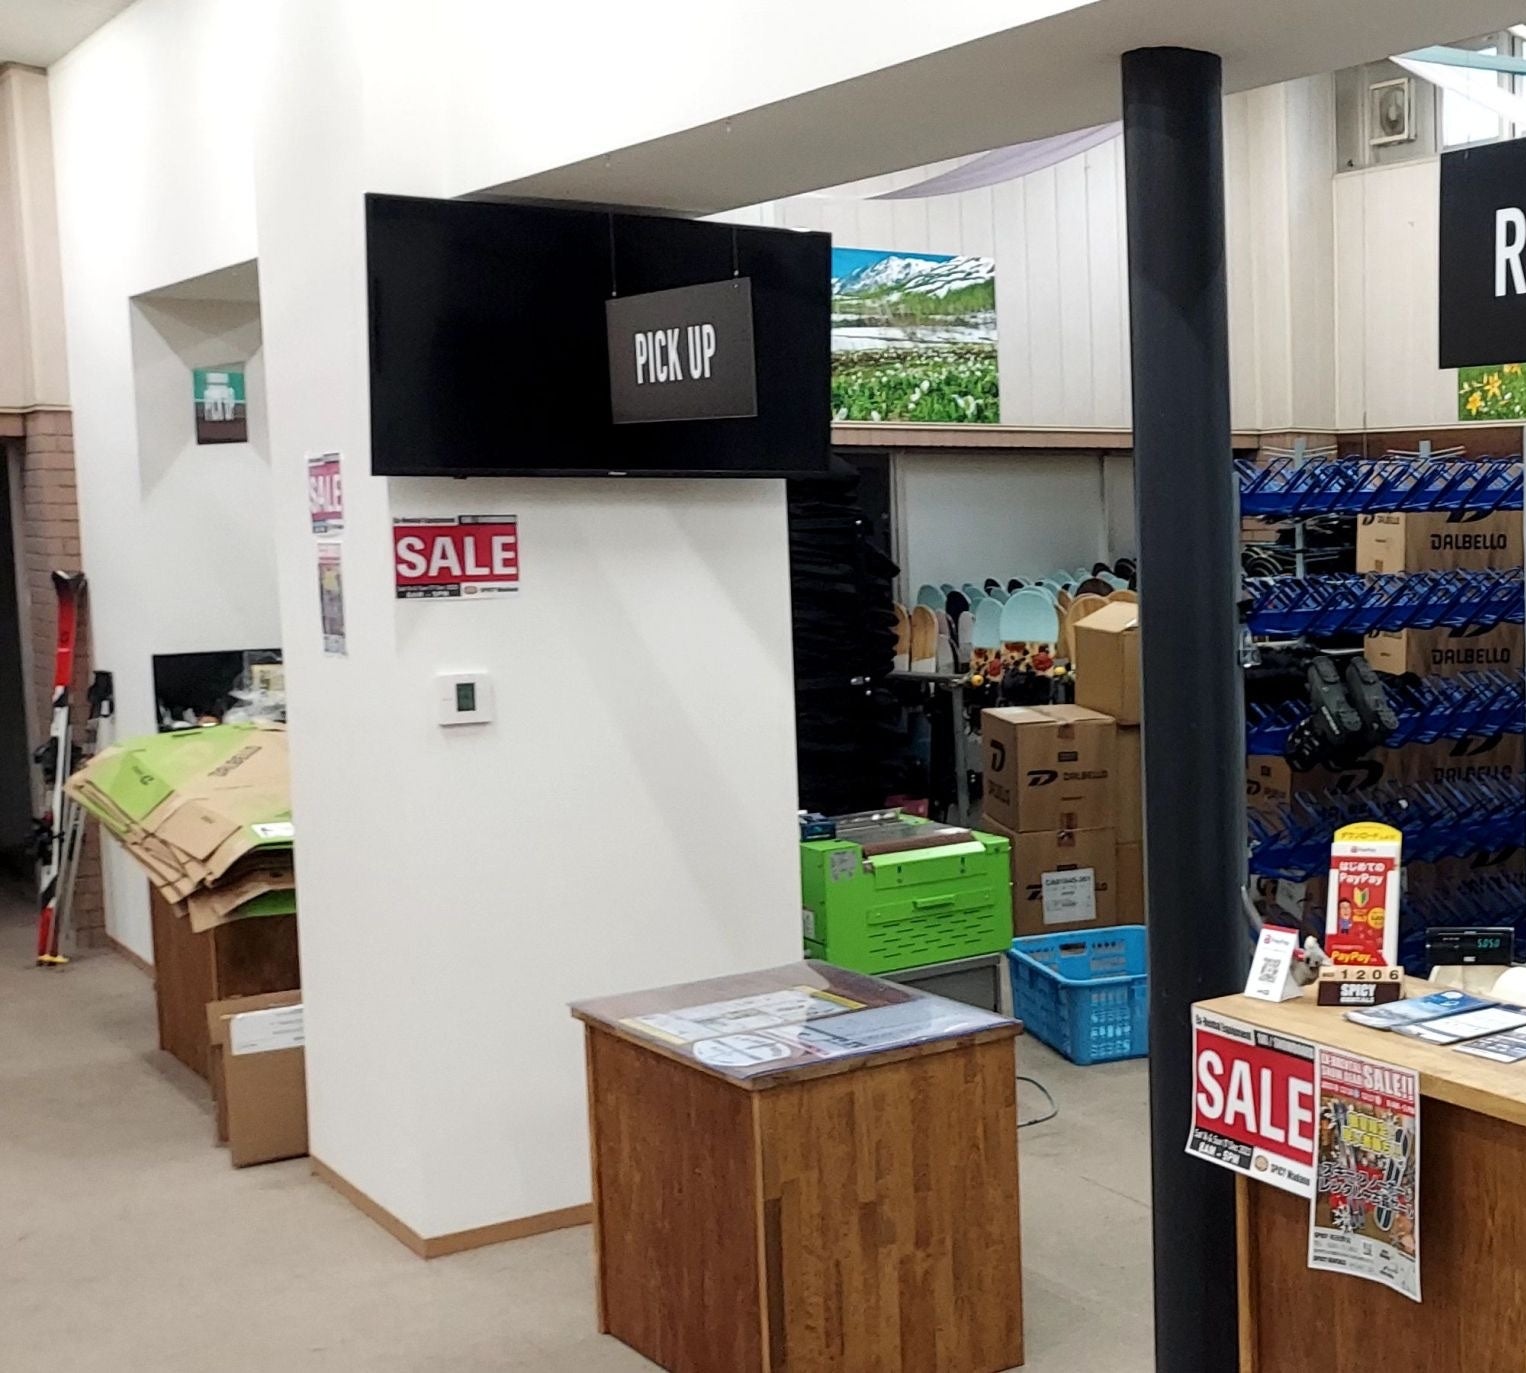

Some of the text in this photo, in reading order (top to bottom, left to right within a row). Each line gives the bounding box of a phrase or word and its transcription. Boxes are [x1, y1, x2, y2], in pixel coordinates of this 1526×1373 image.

[634, 323, 717, 385] PICK UP
[1430, 532, 1508, 551] DALBELLO
[396, 535, 518, 578] SALE
[1431, 647, 1511, 666] DALBELLO
[1338, 860, 1386, 873] はじめての
[1338, 872, 1384, 886] PayPay
[1331, 950, 1371, 963] PayPay
[1340, 983, 1377, 996] SPICY
[1362, 1064, 1415, 1101] SALE!!
[1196, 1048, 1314, 1153] SALE
